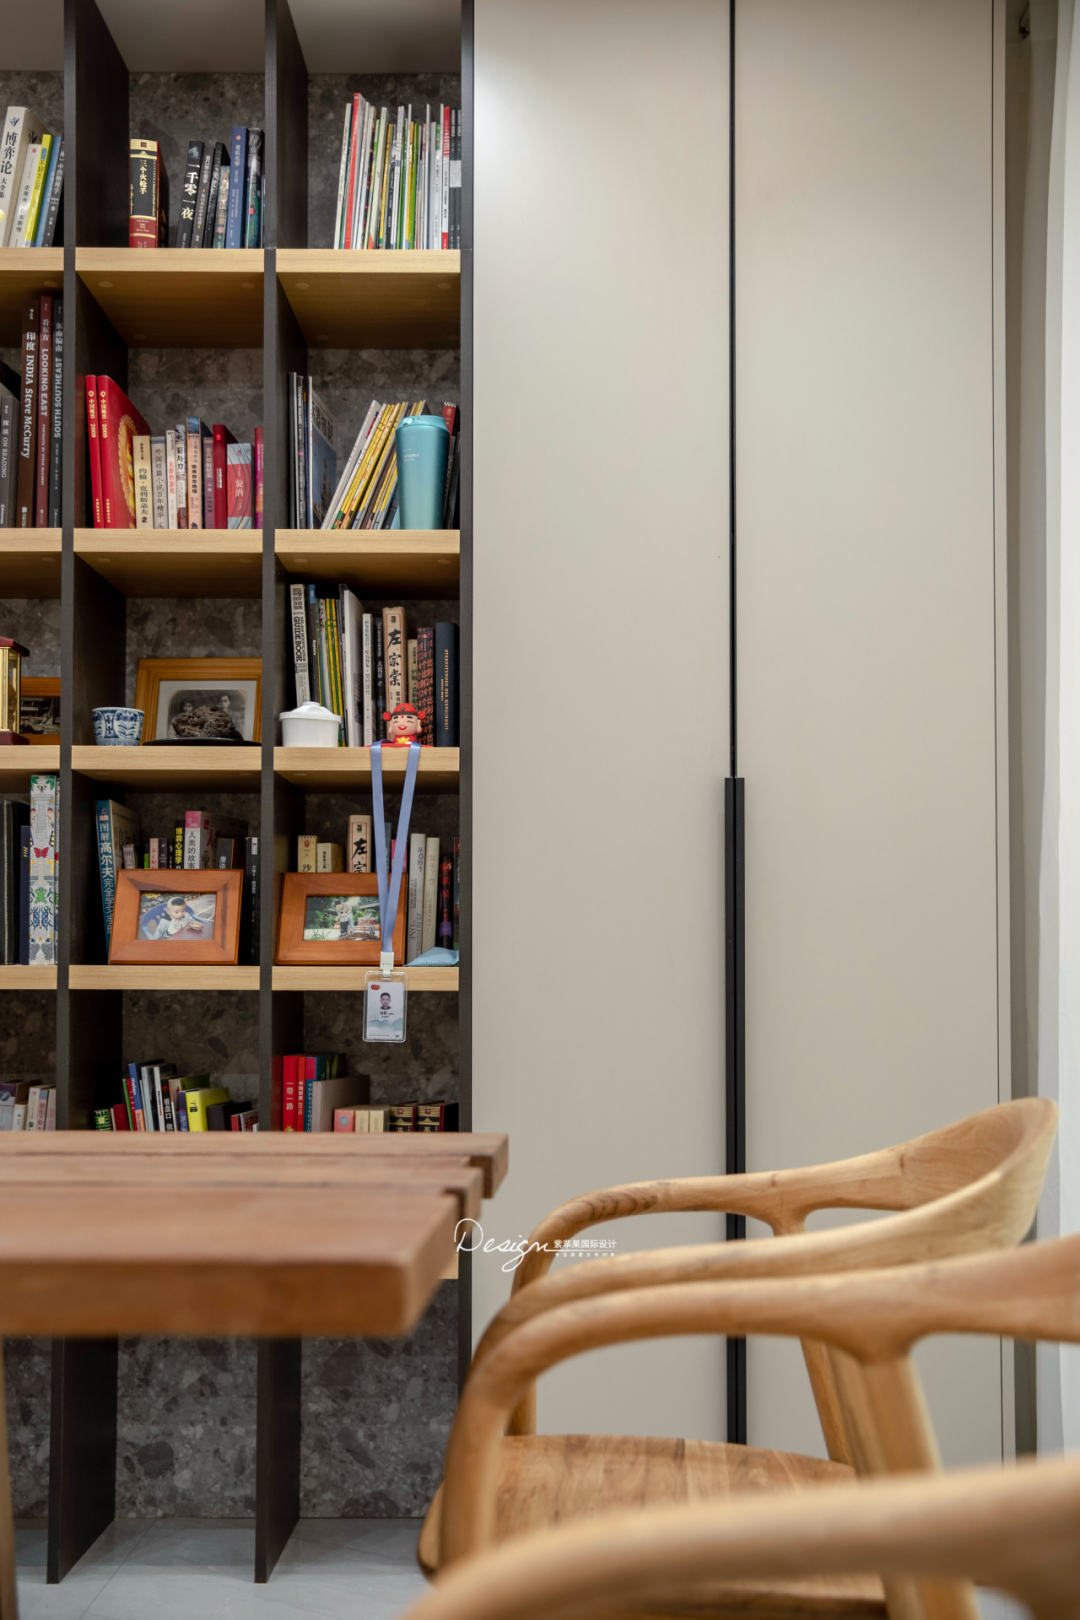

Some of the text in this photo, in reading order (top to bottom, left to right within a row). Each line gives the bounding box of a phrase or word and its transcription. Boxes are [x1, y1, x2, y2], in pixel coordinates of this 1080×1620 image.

[0, 131, 19, 175] 博弈论
[139, 159, 148, 195] 三个火枪手
[181, 163, 201, 221] 一千零一夜
[26, 331, 36, 351] 印度
[25, 354, 35, 386] INDIA
[41, 348, 49, 390] LOOKING
[24, 388, 33, 415] Steve
[40, 391, 48, 417] EAST
[53, 357, 63, 438] SOUTH SOUTHEAST
[20, 416, 32, 459] McCurry
[138, 467, 149, 515] 约翰·克利斯朵夫
[154, 448, 165, 519] 外国短篇小说百年精华
[386, 628, 402, 687] 左宗棠
[175, 827, 183, 864] 博弈心理学
[187, 831, 197, 869] 人类的故事
[285, 1081, 294, 1111] 一带一路
